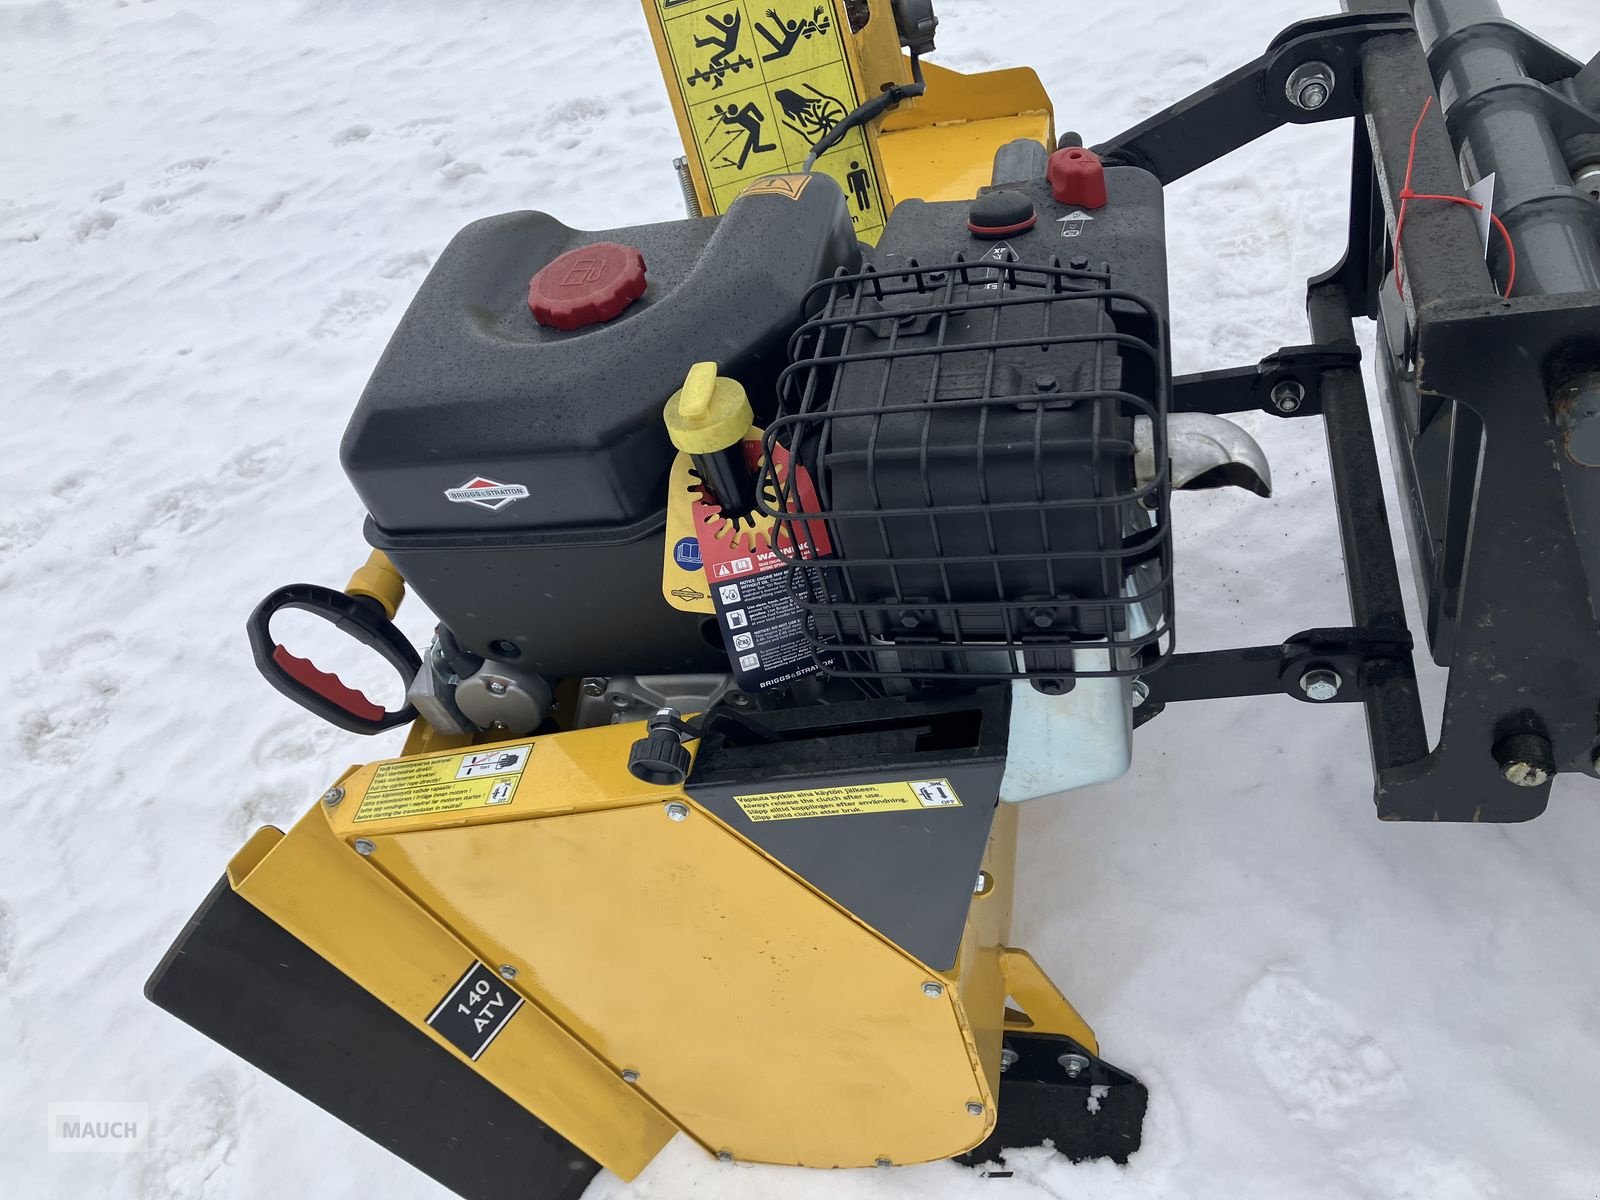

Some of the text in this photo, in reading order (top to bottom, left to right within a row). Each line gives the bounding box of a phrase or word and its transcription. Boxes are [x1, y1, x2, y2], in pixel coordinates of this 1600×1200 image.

[756, 541, 810, 560] WANING
[770, 793, 795, 801] kytkin
[815, 788, 843, 797] käytön
[816, 795, 841, 803] clutch
[790, 803, 834, 812] kopplingen
[859, 798, 908, 806] användning.
[457, 980, 490, 1015] 140
[474, 991, 504, 1034] ATV
